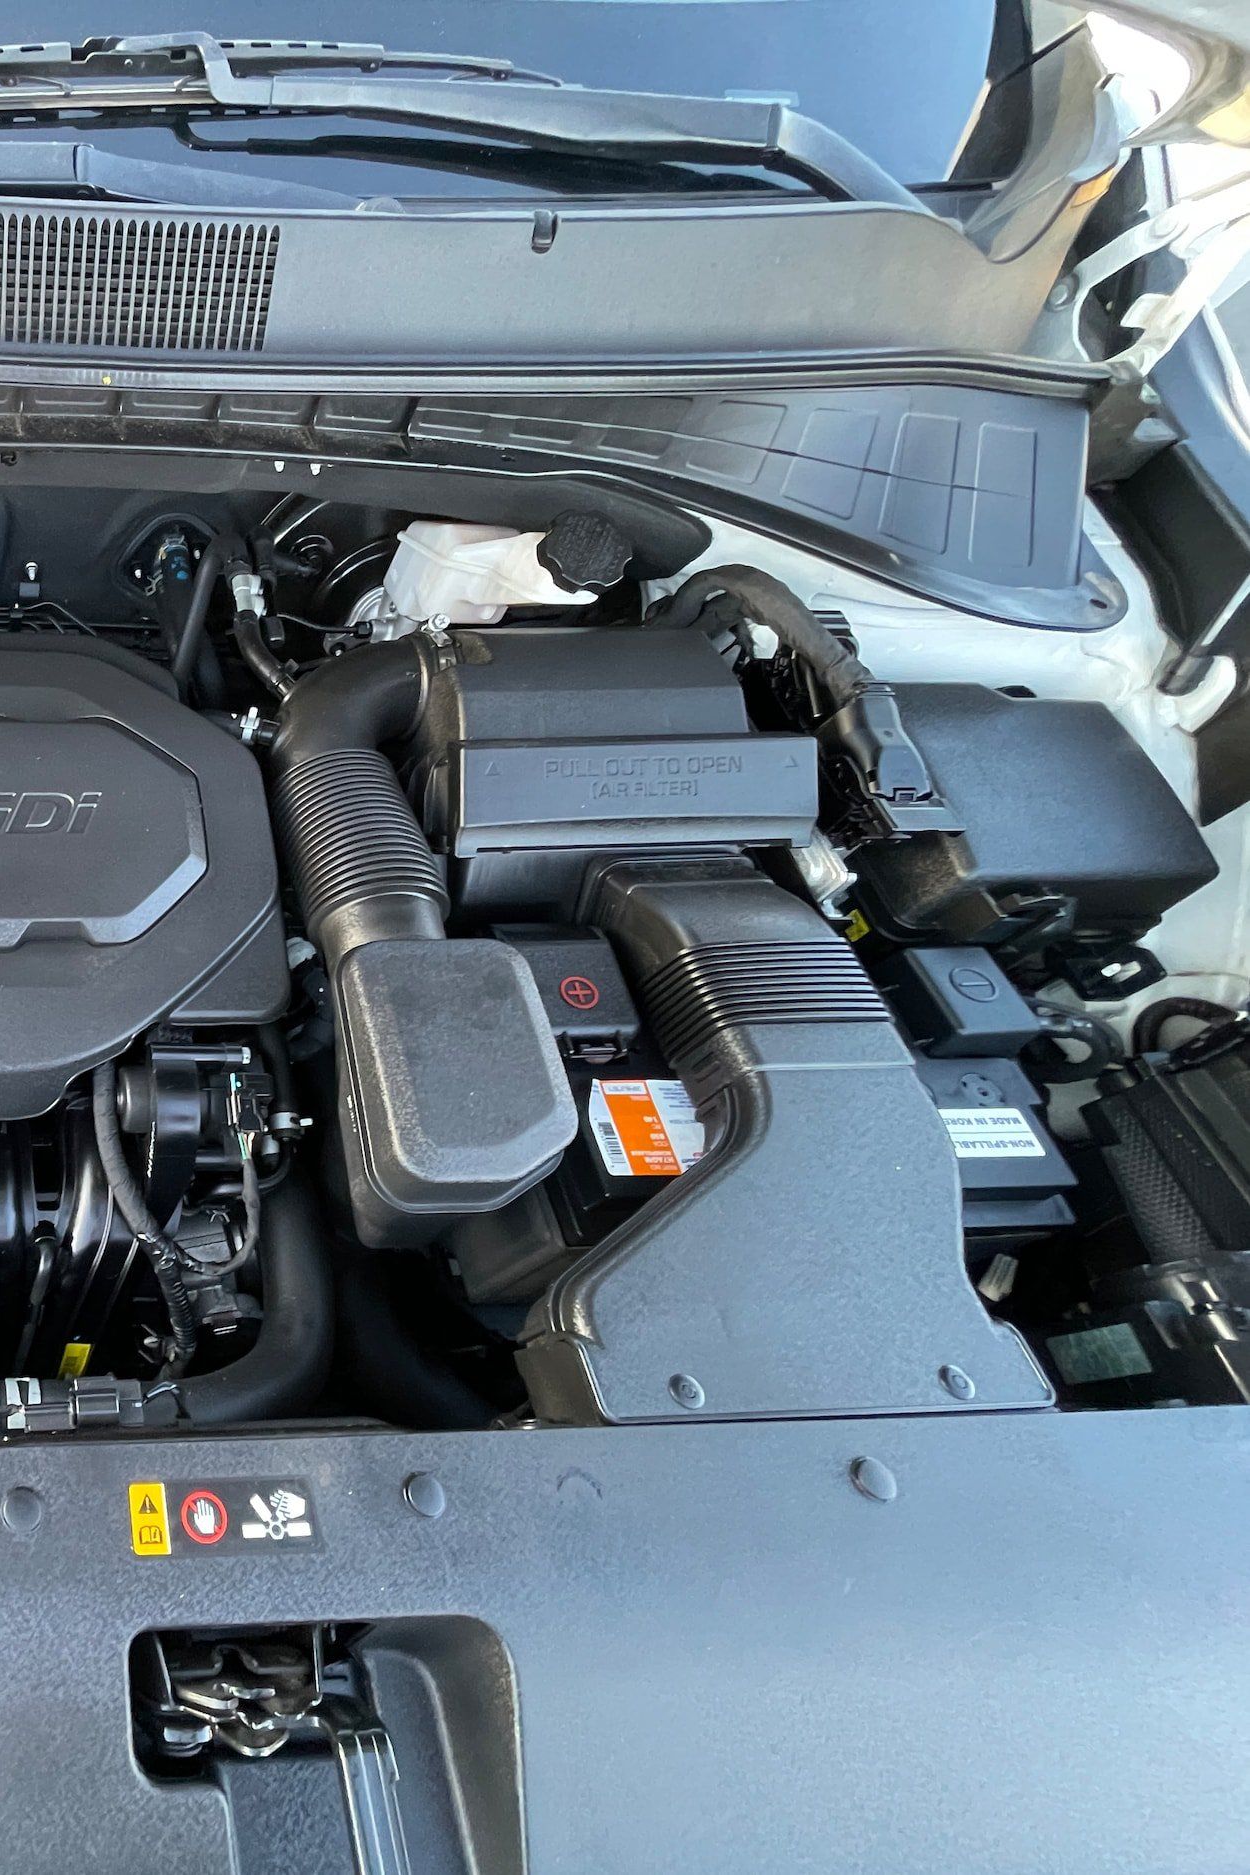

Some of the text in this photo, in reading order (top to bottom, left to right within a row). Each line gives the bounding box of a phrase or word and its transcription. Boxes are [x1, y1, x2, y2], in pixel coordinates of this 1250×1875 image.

[545, 755, 742, 778] PULL OUT TO OPEN
[954, 1140, 1035, 1149] NON-SPILLABL
